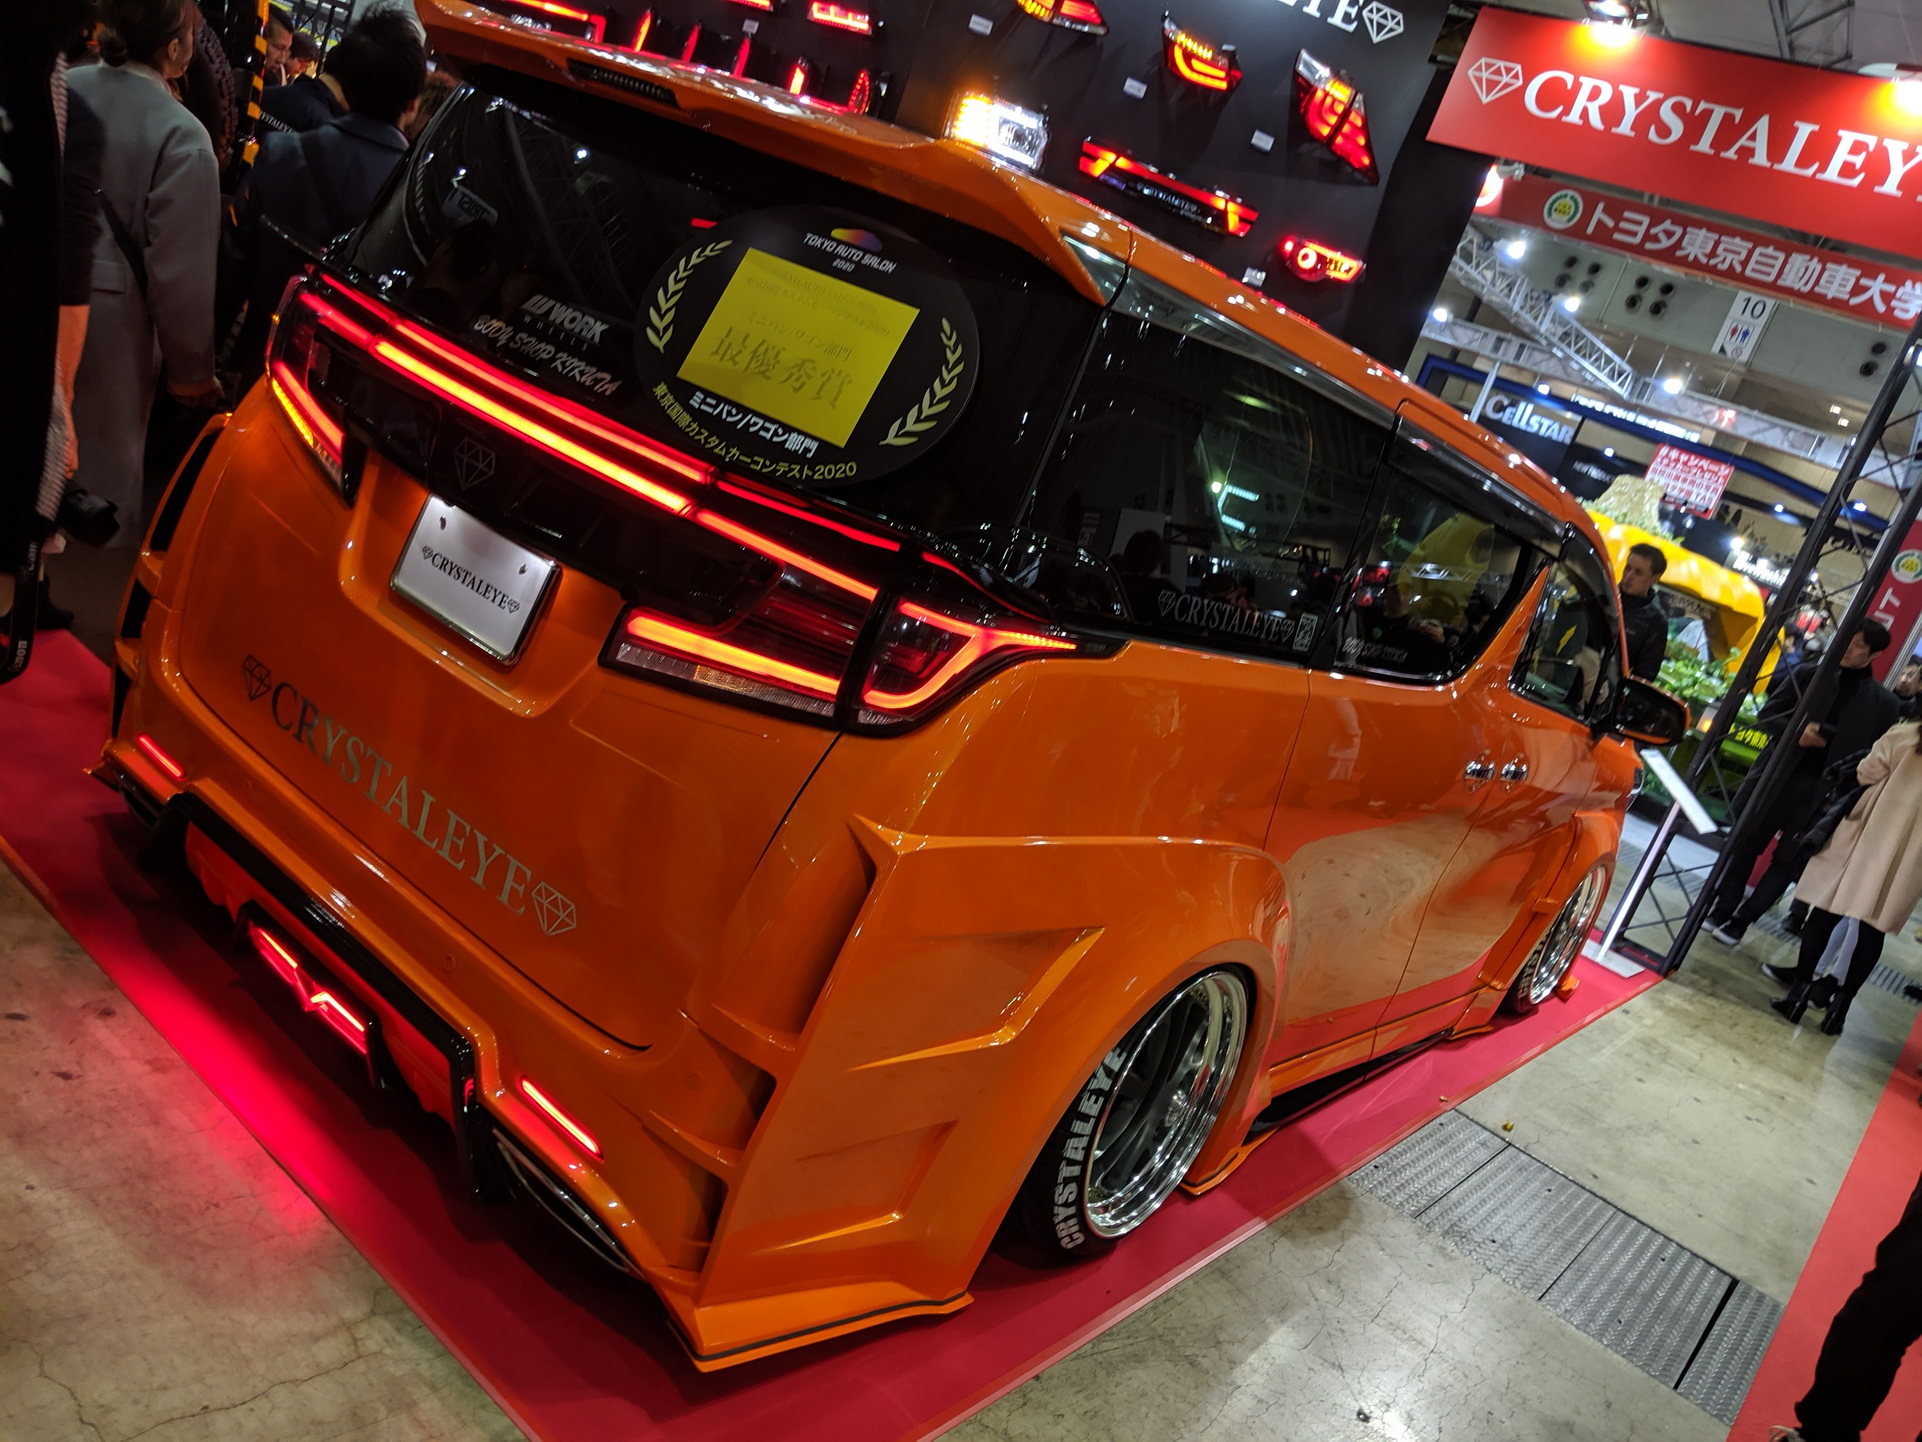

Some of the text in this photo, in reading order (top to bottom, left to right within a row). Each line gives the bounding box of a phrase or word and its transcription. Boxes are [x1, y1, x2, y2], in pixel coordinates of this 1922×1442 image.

[1523, 69, 1922, 204] CRYSTALEY
[802, 232, 898, 274] TOKYO AUTO SALON
[832, 258, 856, 272] 2020
[524, 314, 589, 352] WHEELS
[548, 302, 610, 344] WORK
[1740, 296, 1766, 319] 10
[473, 313, 623, 396] BODY SHOP KIKUTA
[710, 325, 853, 410] 最優秀賞
[652, 381, 857, 481] 東京国際カスタムカーコンテスト2020
[689, 390, 820, 459] ミニバン/ワゴン部門
[431, 550, 509, 611] CRYSTALEYE
[1174, 594, 1284, 642] CRYSTALEYE
[271, 682, 532, 916] CRYSTALEYE
